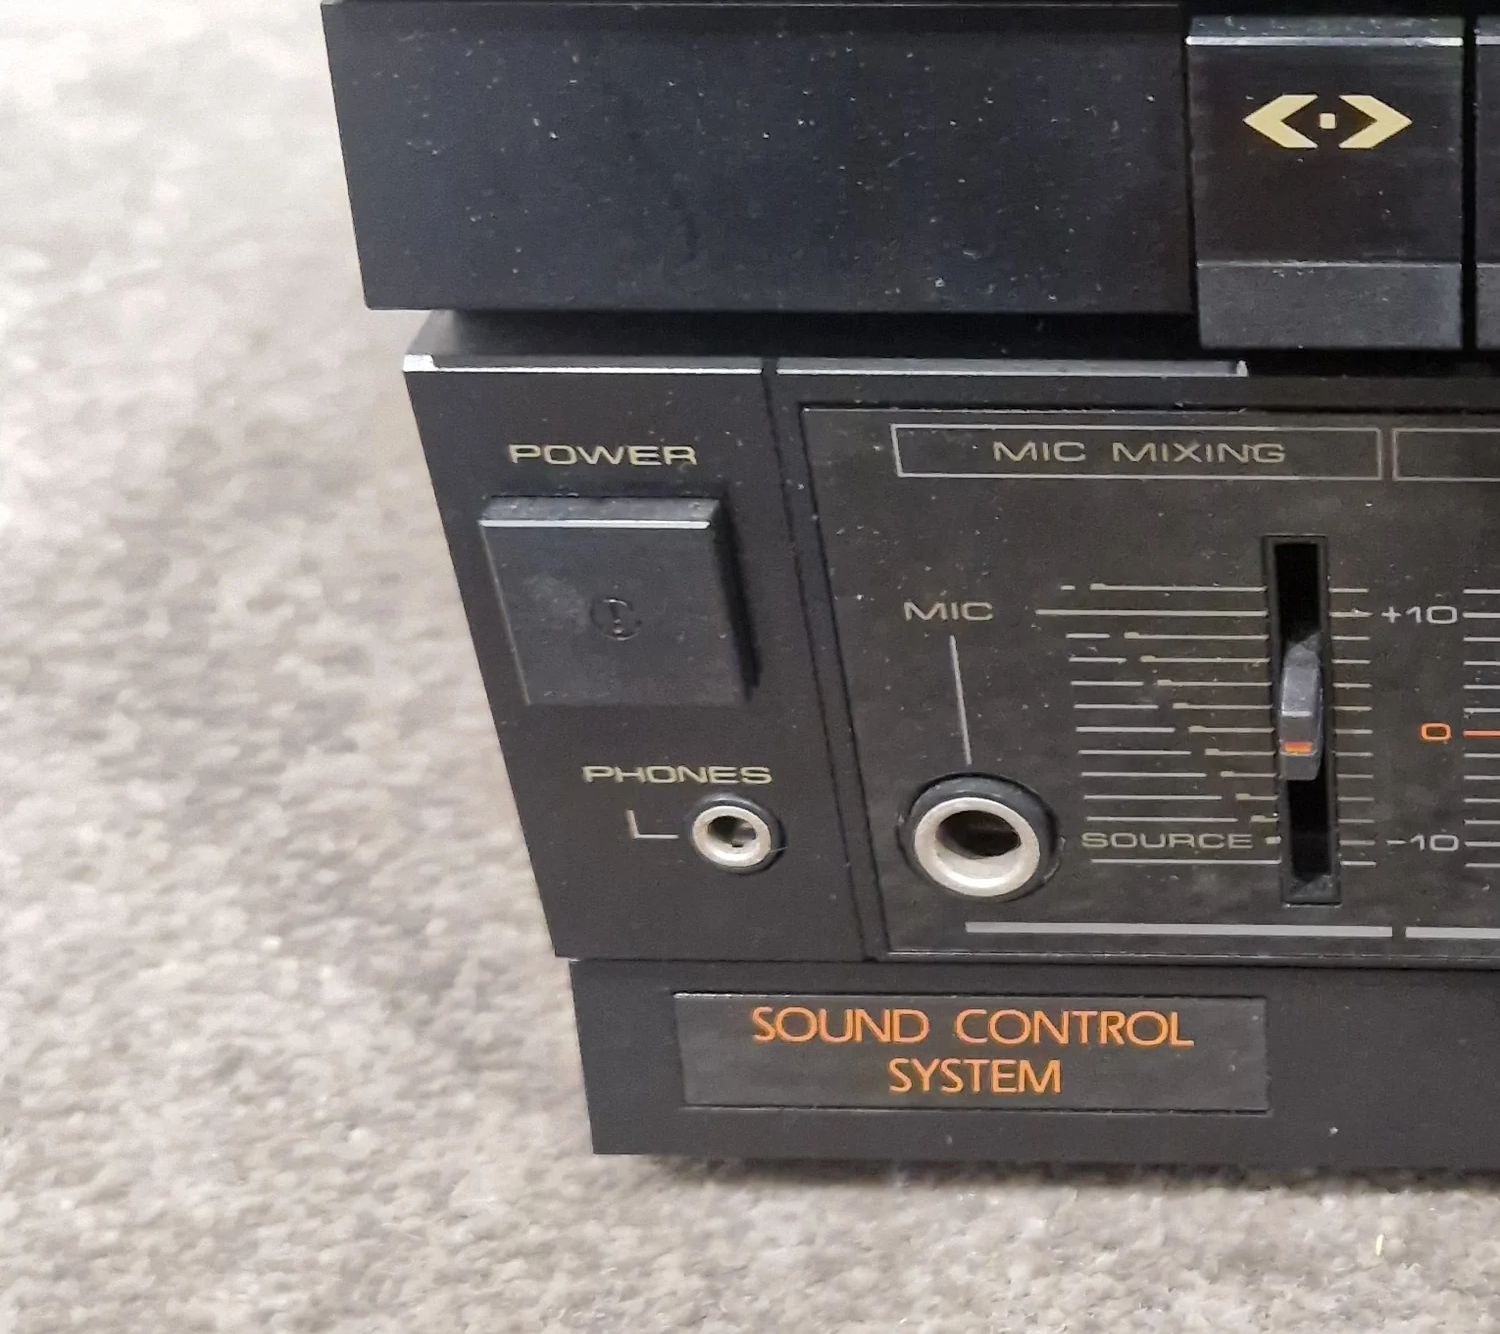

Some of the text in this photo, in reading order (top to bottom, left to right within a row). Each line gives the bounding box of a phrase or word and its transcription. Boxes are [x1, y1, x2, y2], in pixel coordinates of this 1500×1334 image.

[507, 442, 698, 467] POWER
[992, 440, 1286, 464] MIC MIXING
[903, 602, 994, 622] MIC
[581, 765, 774, 786] PHONES
[1080, 831, 1254, 851] SOURCE
[752, 1006, 1195, 1048] SOUND CONTROL
[887, 1058, 1064, 1095] SYSTEM
